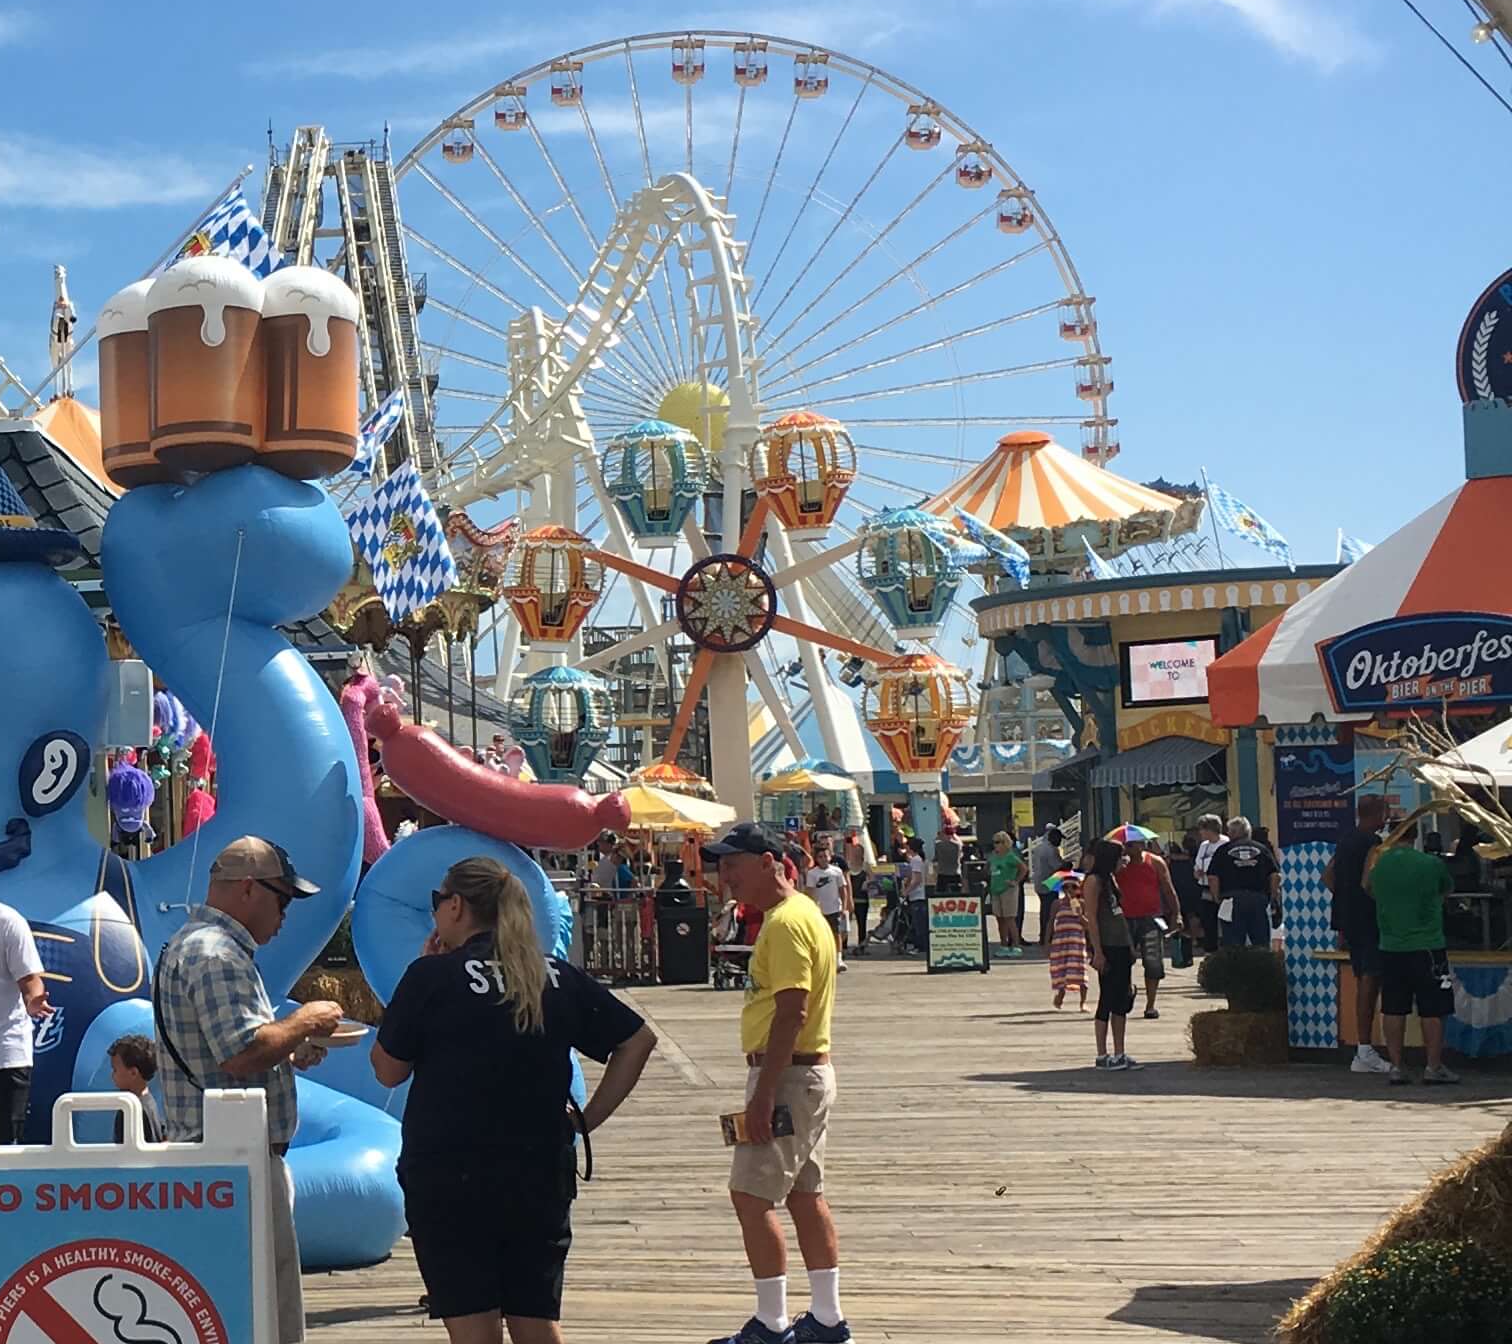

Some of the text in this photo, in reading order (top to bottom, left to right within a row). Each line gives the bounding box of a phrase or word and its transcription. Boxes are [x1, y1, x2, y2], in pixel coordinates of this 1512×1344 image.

[1149, 658, 1196, 670] WELCOME
[1346, 630, 1512, 690] Oktoberfes
[1167, 671, 1180, 681] TO
[1391, 680, 1419, 699] BIER
[1459, 678, 1487, 696] PIER
[1120, 716, 1225, 744] TICKETS
[464, 957, 561, 994] STF
[35, 1181, 234, 1212] SMOKING
[25, 1270, 40, 1287] IS
[41, 1263, 53, 1276] A
[54, 1247, 120, 1270] HEALTHY,
[123, 1250, 201, 1308] SMOKE-FREE
